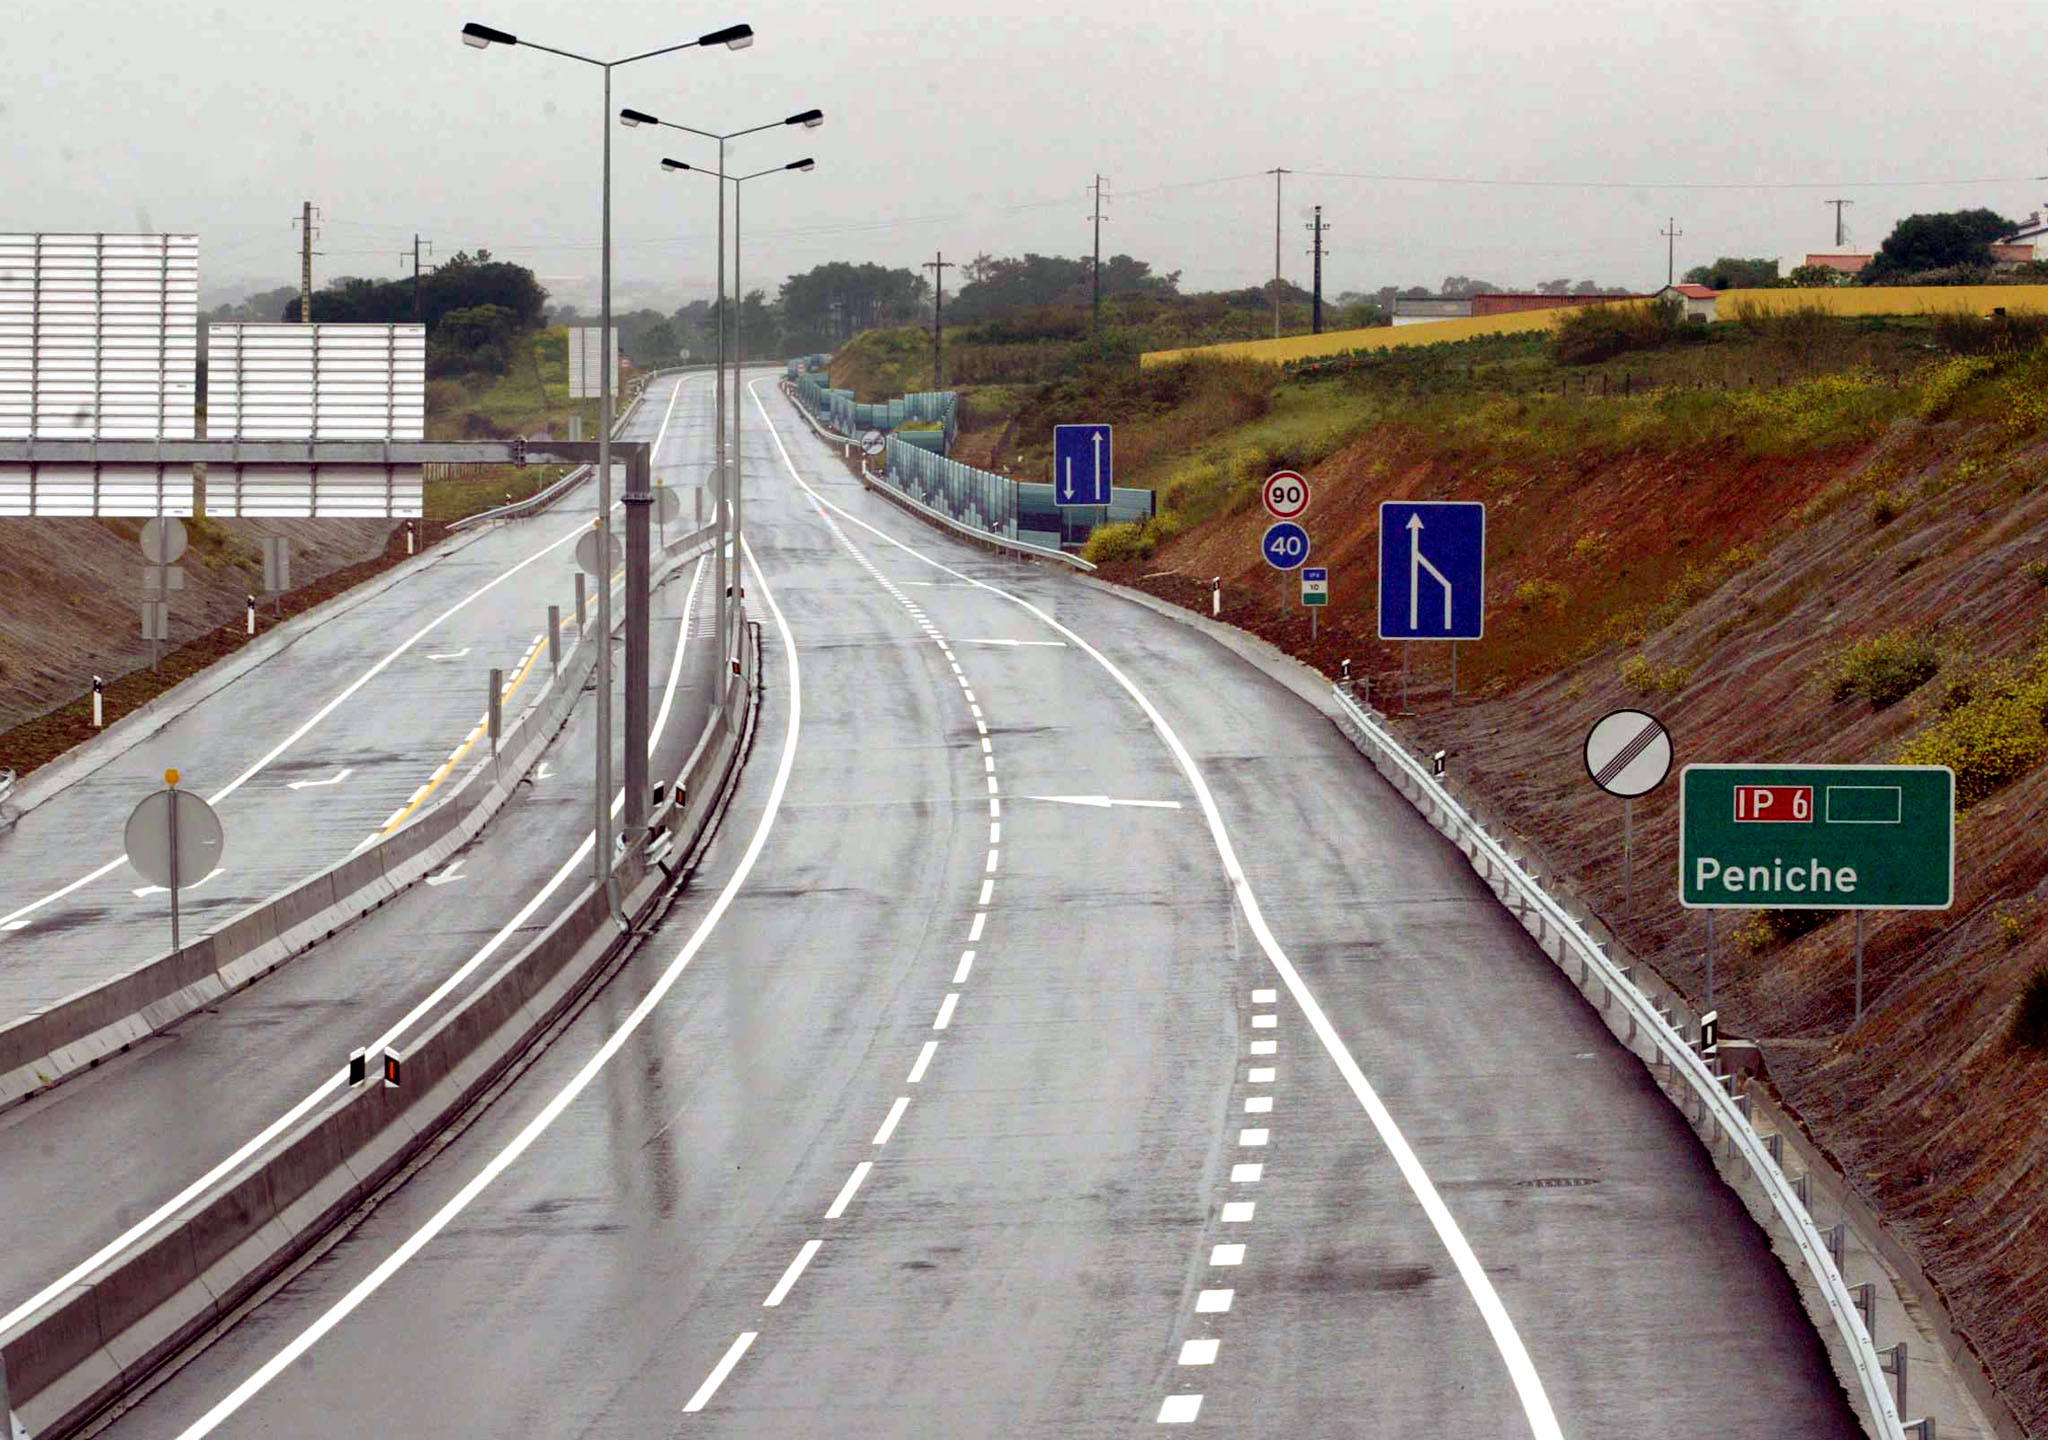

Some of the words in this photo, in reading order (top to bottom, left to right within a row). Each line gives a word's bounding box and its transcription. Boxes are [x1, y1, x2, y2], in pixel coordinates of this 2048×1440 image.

[1272, 486, 1301, 504] 90
[1270, 536, 1301, 556] 40
[1738, 789, 1774, 819] IP
[1792, 789, 1808, 819] 6
[1696, 857, 1858, 892] Peniche
